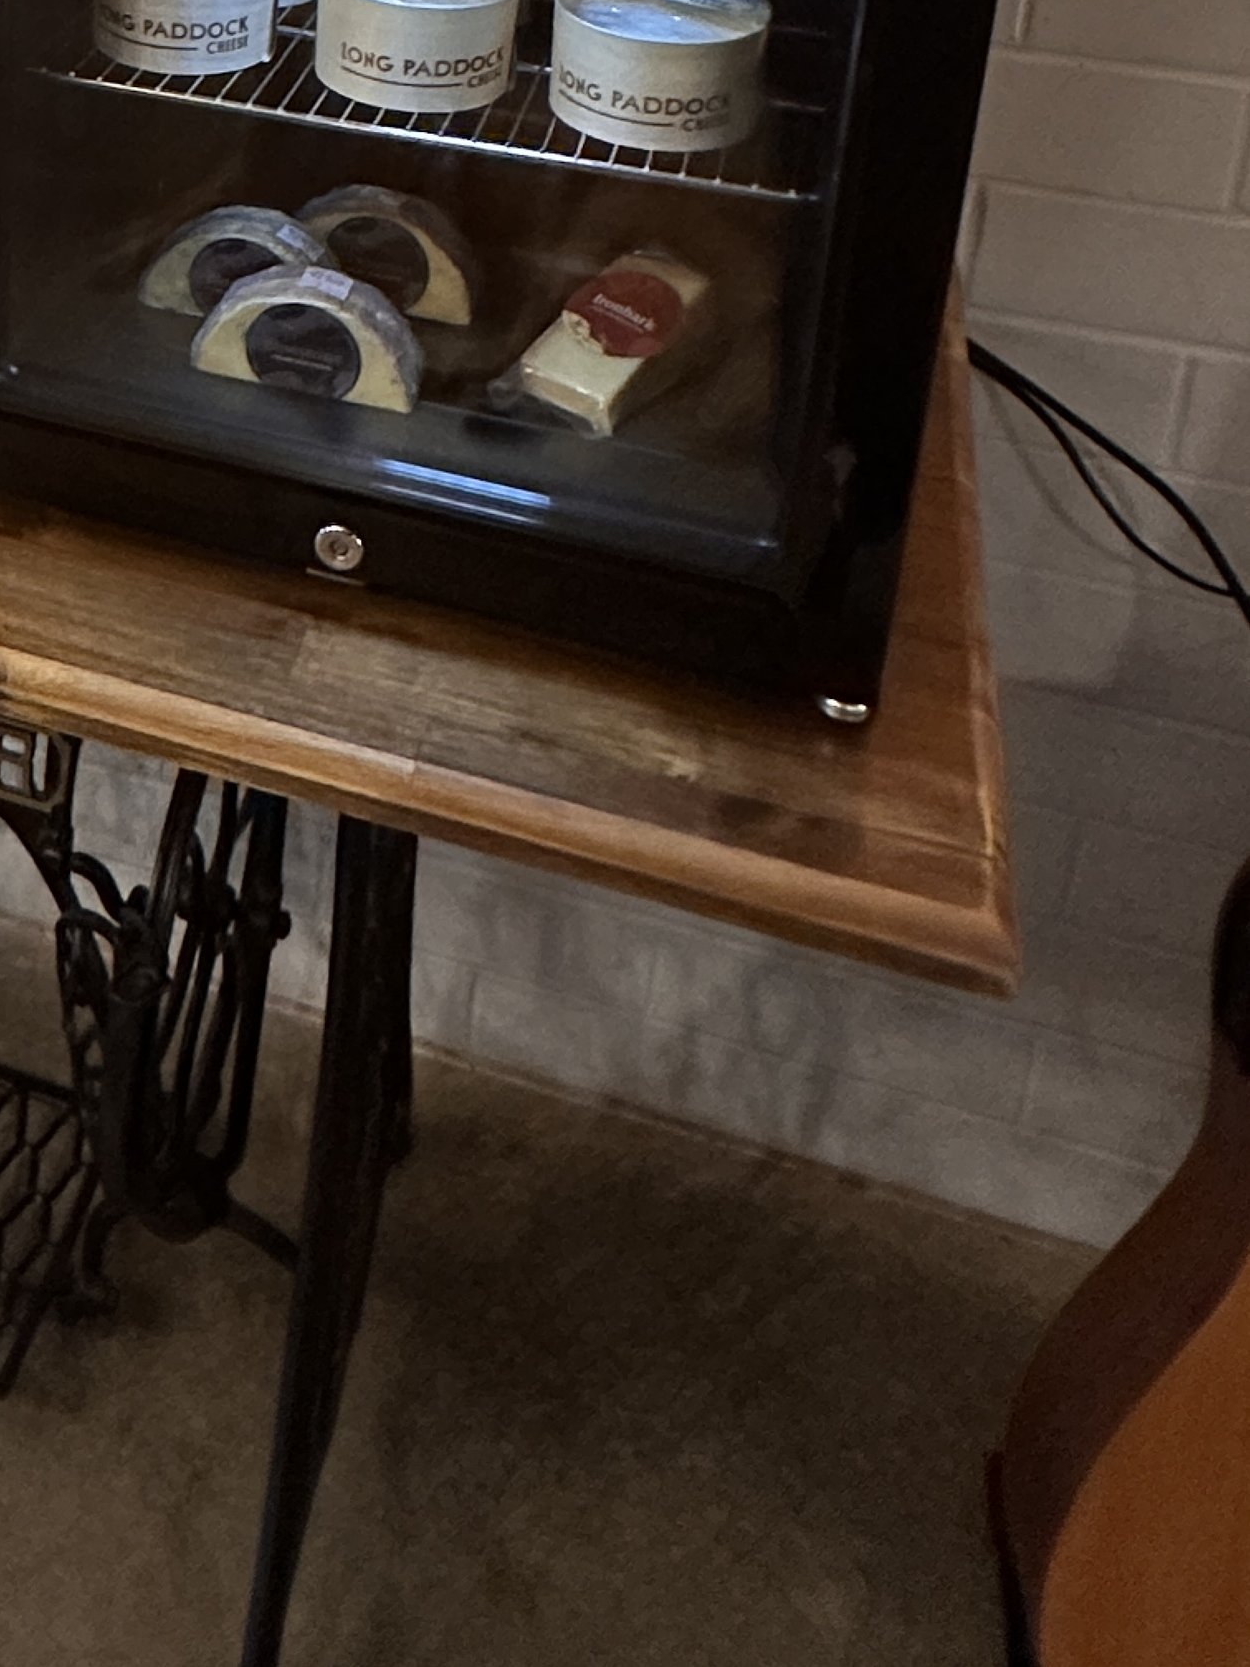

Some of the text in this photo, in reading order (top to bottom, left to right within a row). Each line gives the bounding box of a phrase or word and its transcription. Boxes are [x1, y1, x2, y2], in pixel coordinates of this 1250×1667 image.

[143, 15, 249, 40] PADDOCK
[206, 35, 249, 54] CHEESE
[340, 42, 505, 77] LONG PADDOCK
[558, 63, 732, 116] LONG PADDOCK
